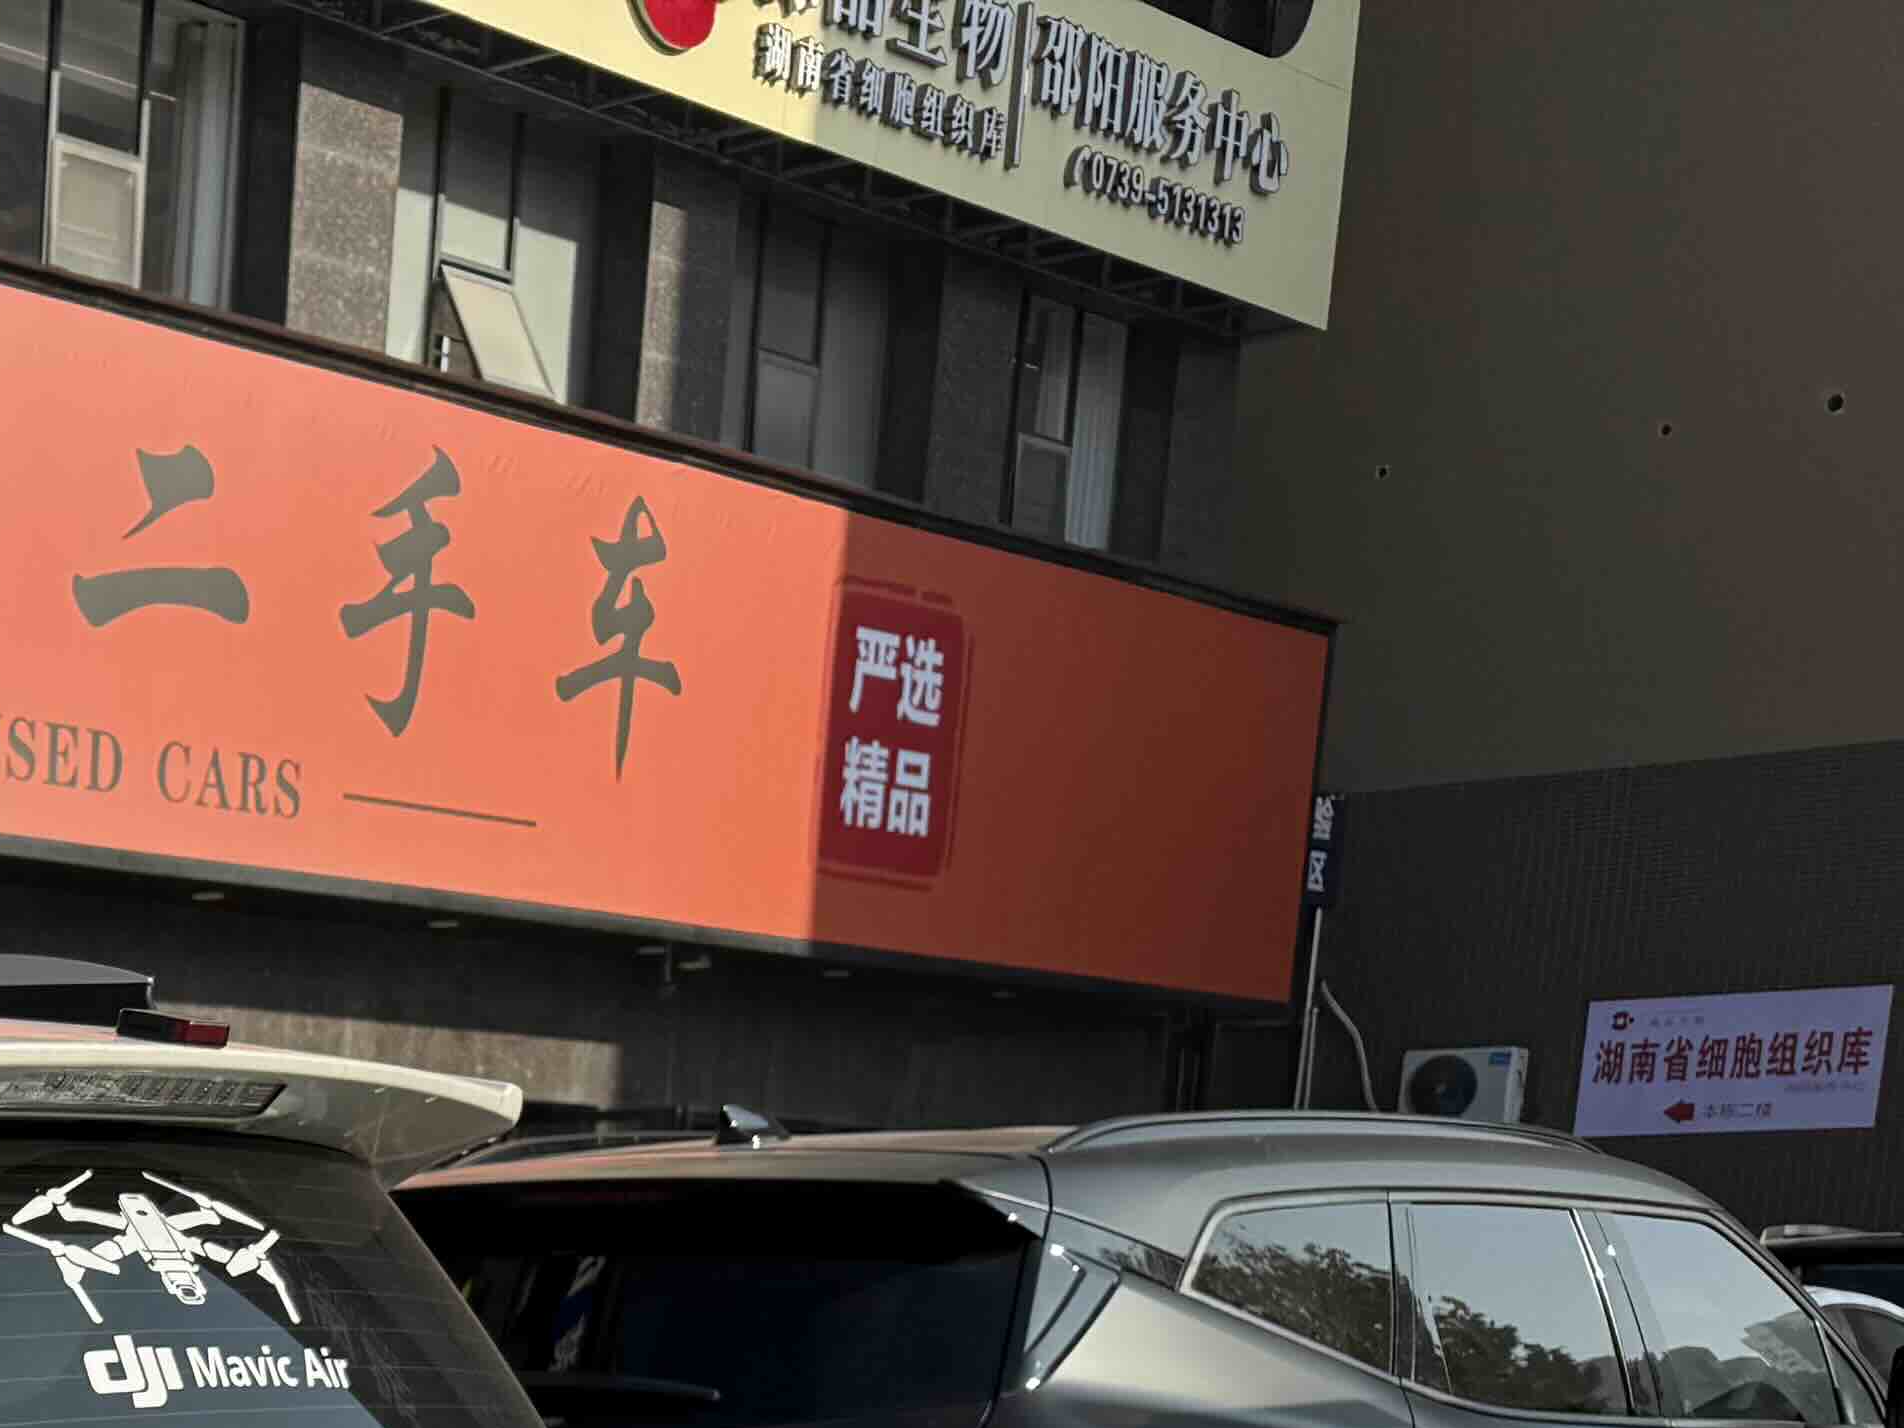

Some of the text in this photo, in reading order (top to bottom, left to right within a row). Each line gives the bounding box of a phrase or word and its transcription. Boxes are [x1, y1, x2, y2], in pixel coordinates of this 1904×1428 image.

[755, 23, 1009, 161] 湖南省细胞组织库
[1034, 16, 1289, 193] 邵阳服务中心
[1089, 150, 1247, 244] 0739-5131313
[848, 626, 944, 727] 严选
[156, 740, 303, 820] CARS
[840, 736, 932, 837] 精品
[1592, 1026, 1874, 1085] 湖南省细胞组织库
[185, 1345, 299, 1391] Mavic
[303, 1347, 350, 1390] Air
